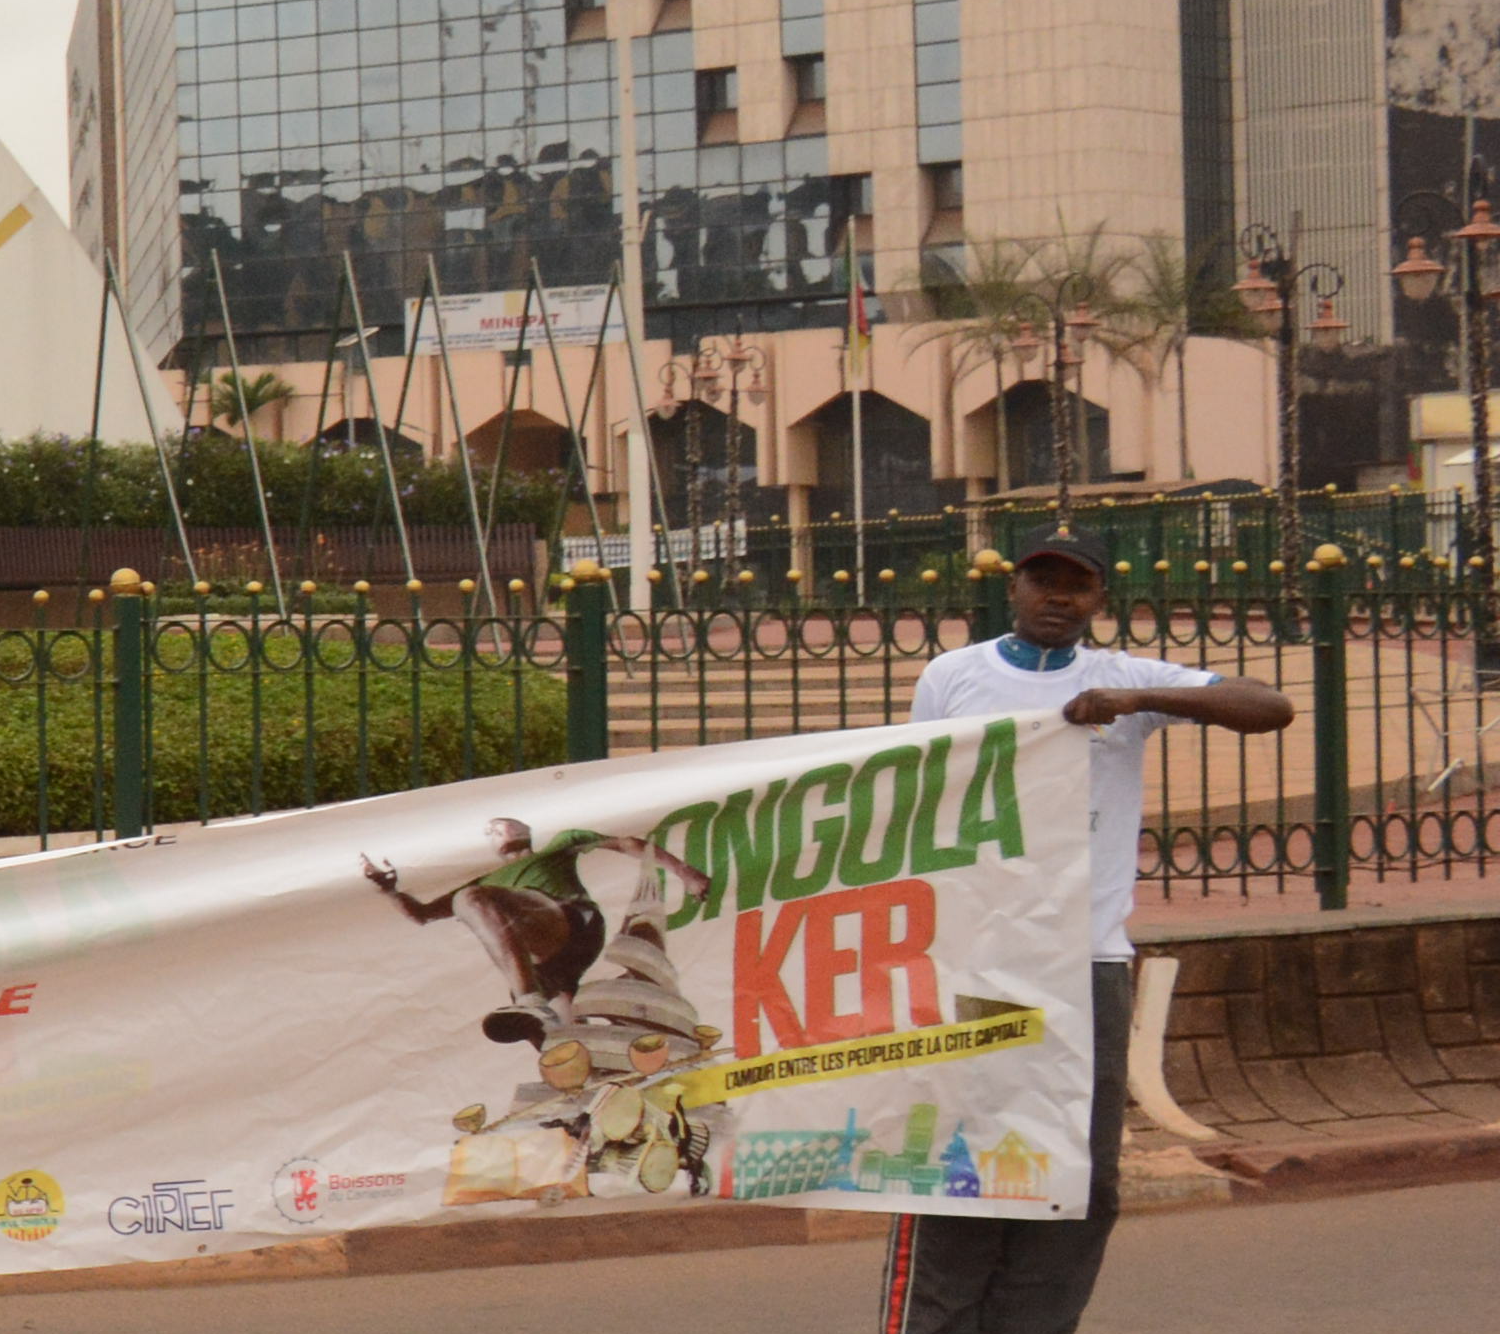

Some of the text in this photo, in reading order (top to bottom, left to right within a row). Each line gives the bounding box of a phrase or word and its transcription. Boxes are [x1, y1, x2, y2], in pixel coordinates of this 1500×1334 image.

[647, 718, 1025, 931] ONGOLA
[732, 877, 944, 1061] KER
[778, 1055, 817, 1079] ENTRE
[822, 1052, 845, 1071] LES
[848, 1041, 904, 1069] PEUPLES
[907, 1037, 922, 1059] DE
[926, 1034, 942, 1055] LA
[975, 1019, 1028, 1048] CAPITALE
[328, 1174, 406, 1189] Boissons
